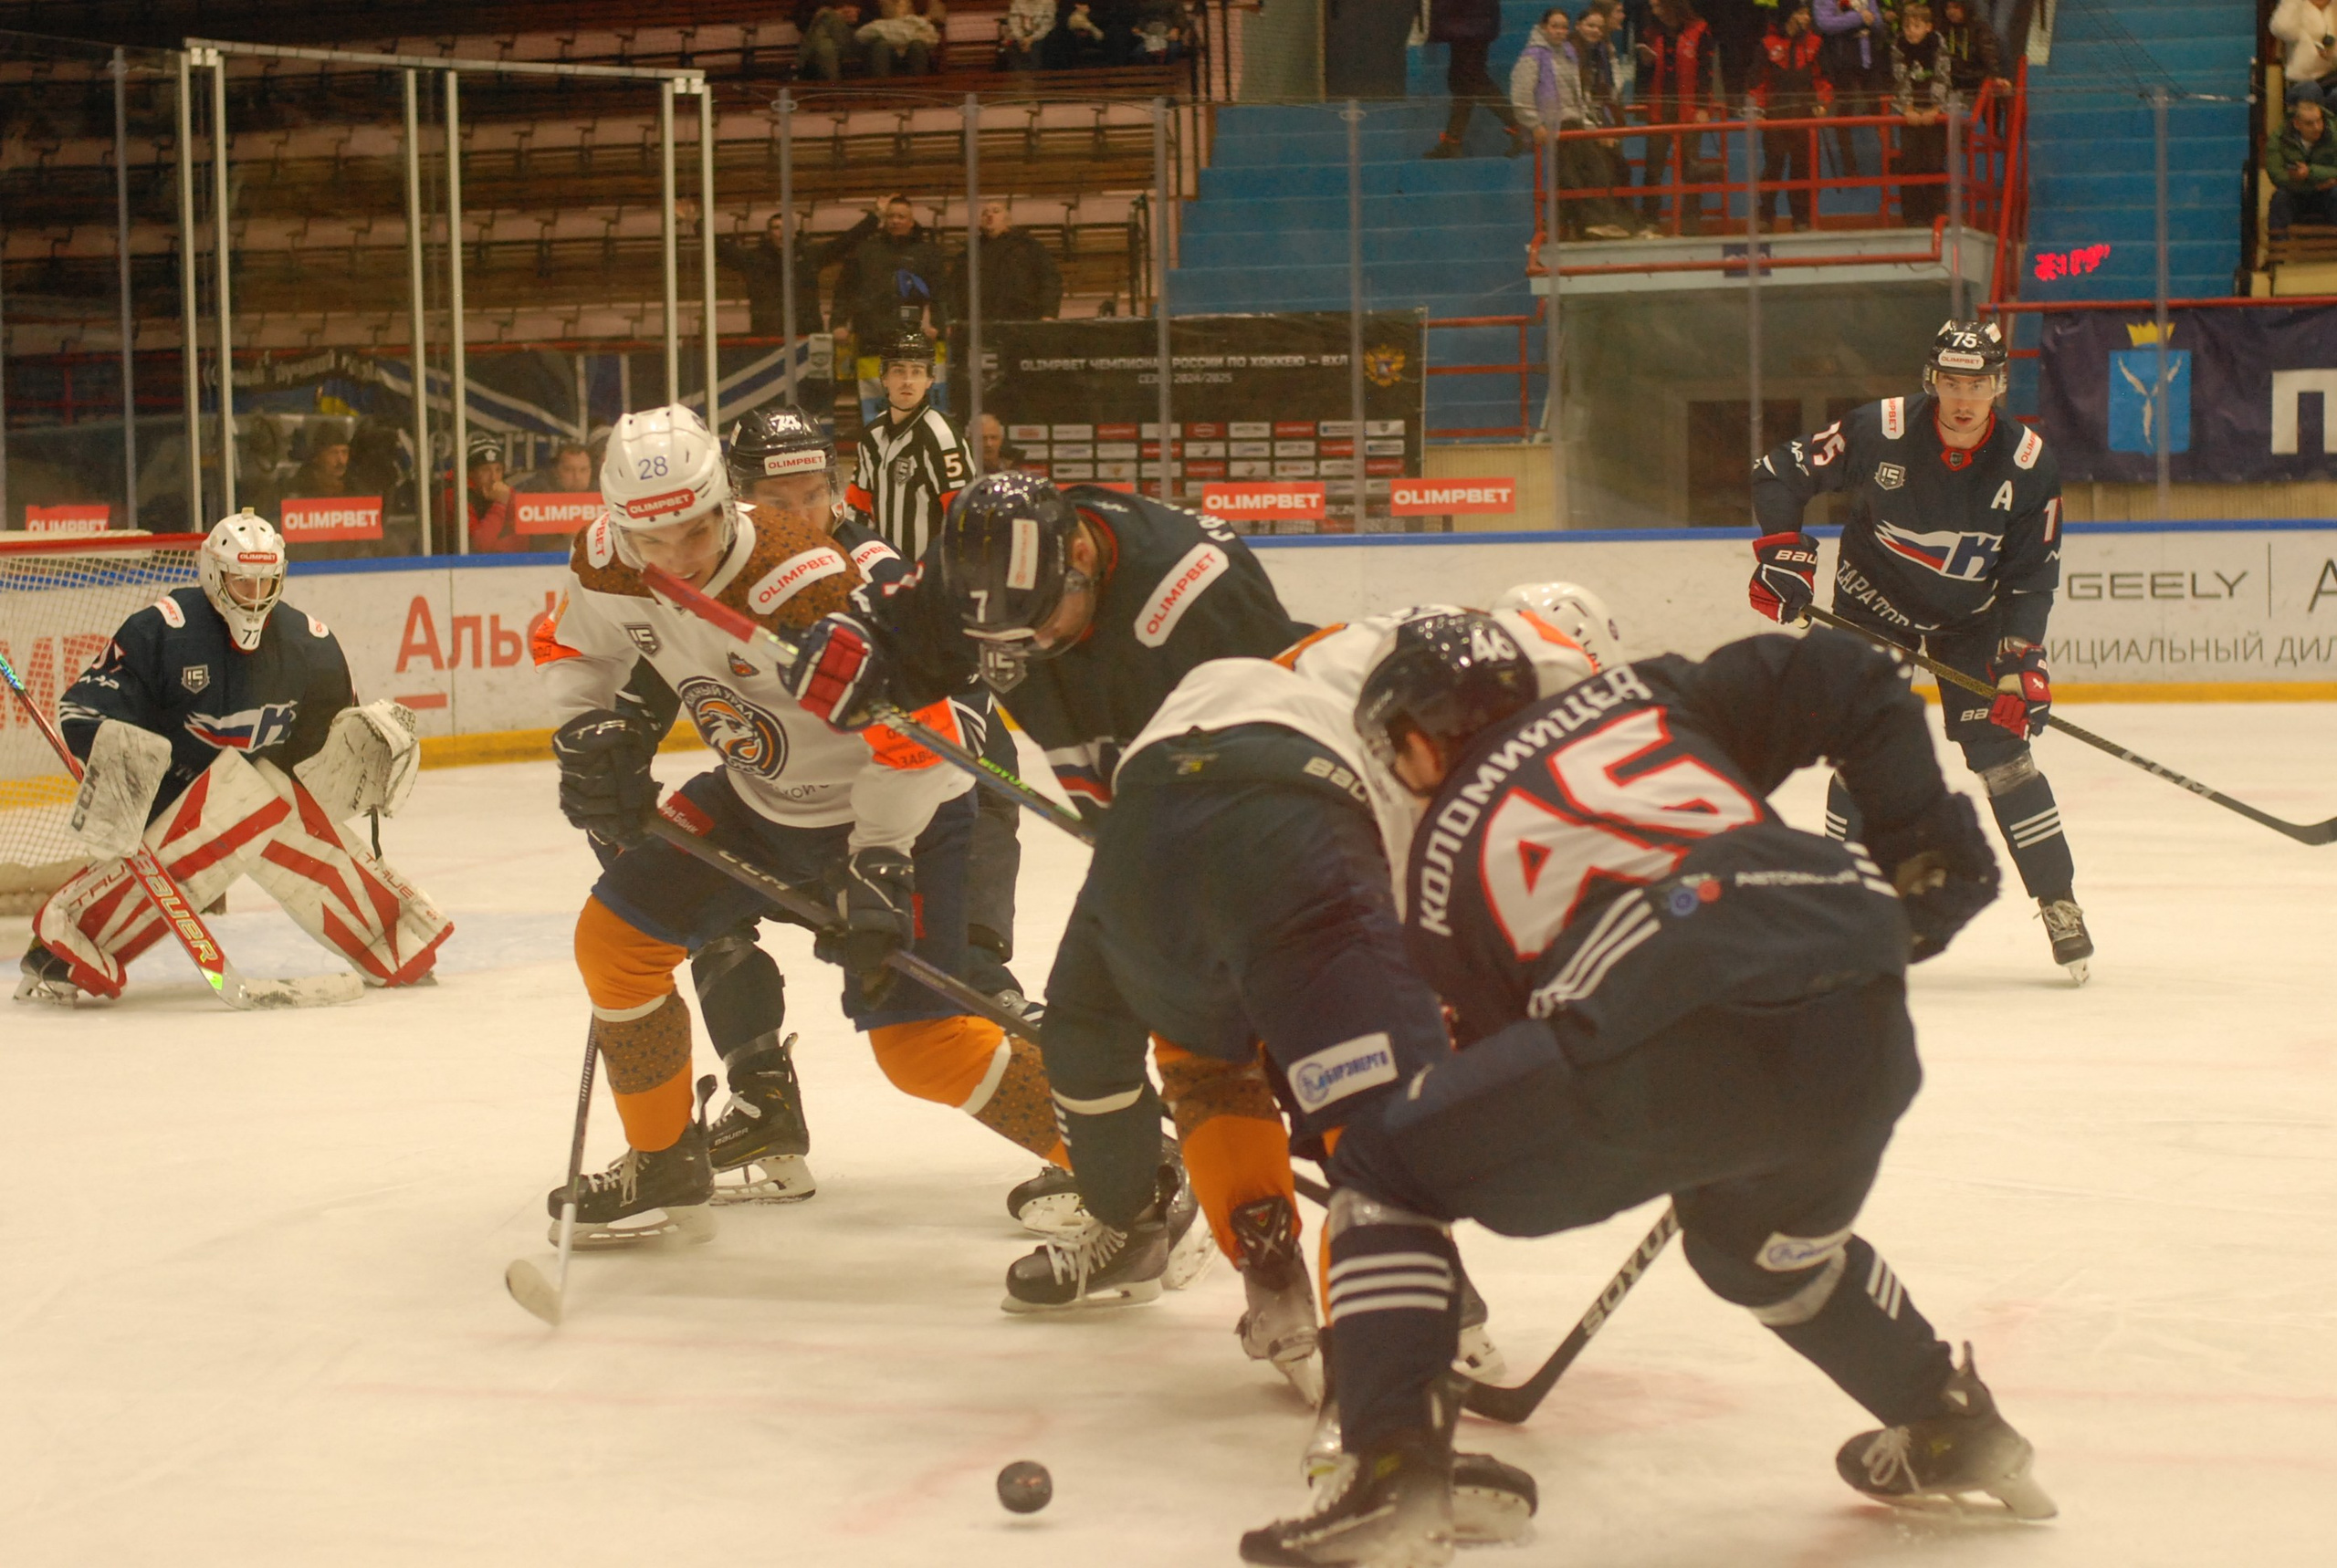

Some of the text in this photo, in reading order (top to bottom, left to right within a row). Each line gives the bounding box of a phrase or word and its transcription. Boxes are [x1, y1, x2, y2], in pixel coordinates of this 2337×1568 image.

[1952, 331, 1977, 348] 75
[1089, 357, 1167, 370] ЧЕМПИОНА
[1227, 356, 1247, 367] ПО
[1321, 354, 1348, 366] ВХЛ
[1941, 356, 1980, 365] OLIMPBET
[770, 414, 802, 433] 74
[638, 455, 668, 481] 28
[768, 455, 823, 469] OLIMPBET
[943, 454, 963, 478] 5
[629, 494, 690, 514] OLIMPBET
[1205, 494, 1321, 509] OLIMPBET
[1393, 488, 1512, 505] OLIMPBET
[1990, 480, 2013, 512] A
[284, 509, 380, 530] OLIMPBET
[519, 503, 608, 522] OLIMPBE
[239, 552, 277, 561] OLIMPBET
[758, 554, 836, 604] OLIMPBET
[2067, 570, 2248, 601] GEELY
[1146, 552, 1217, 635] OLIMPBET
[969, 590, 989, 623] 7
[242, 629, 260, 645] 77
[1471, 629, 1518, 664] 46
[2050, 630, 2264, 670] ИЦИАЛЬНЫЙ
[2121, 749, 2216, 799] CCM
[68, 863, 126, 907] TRU
